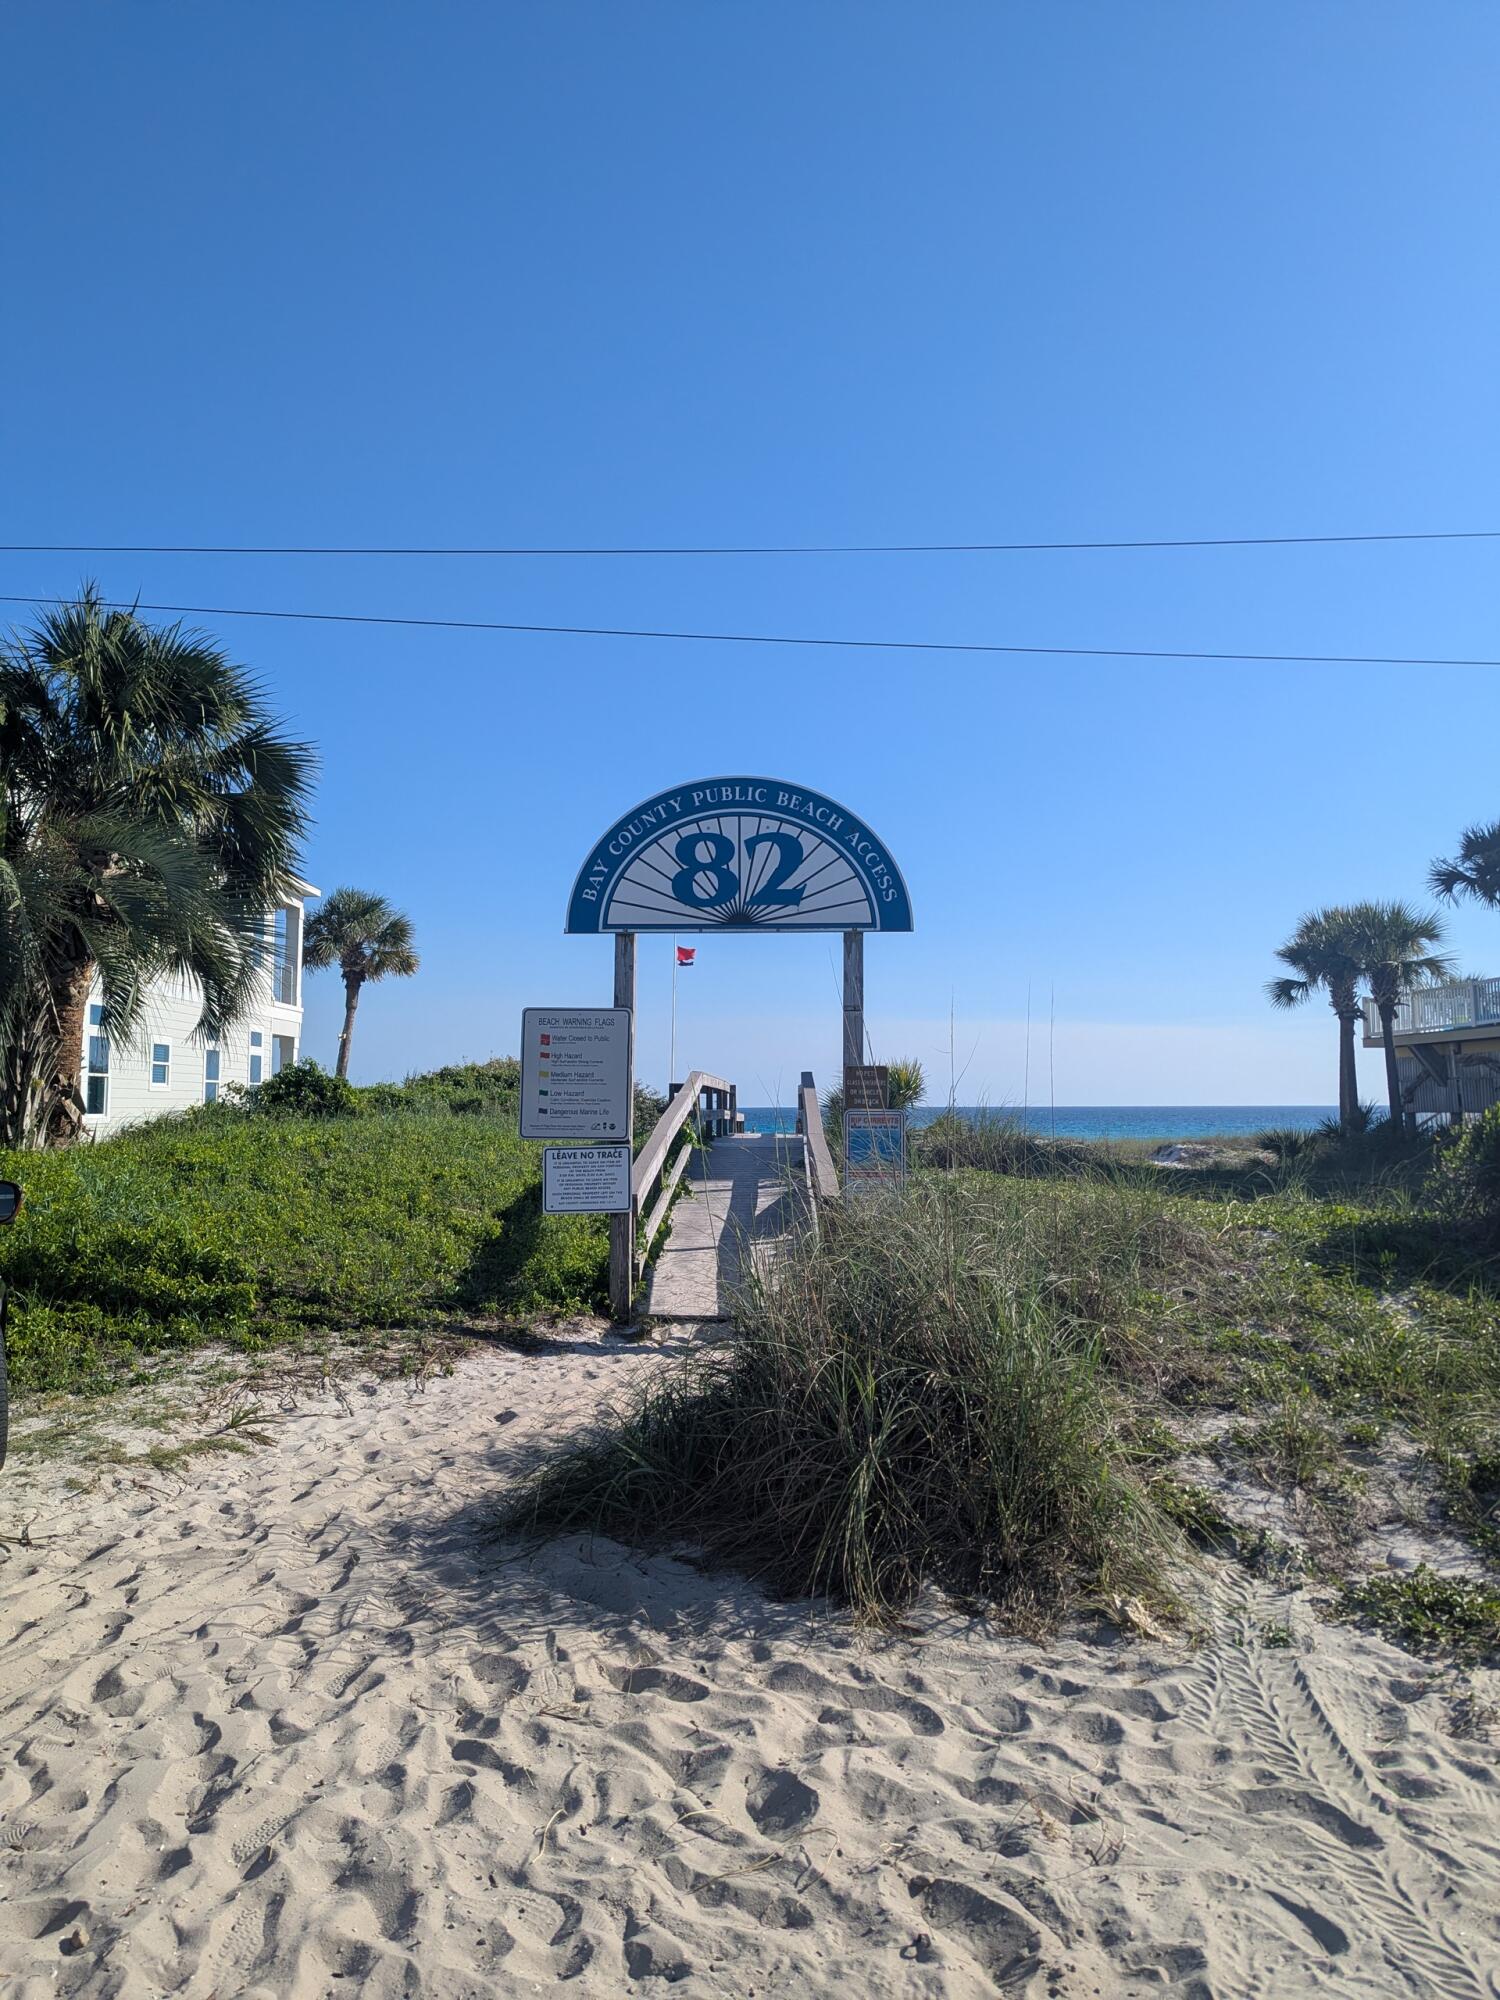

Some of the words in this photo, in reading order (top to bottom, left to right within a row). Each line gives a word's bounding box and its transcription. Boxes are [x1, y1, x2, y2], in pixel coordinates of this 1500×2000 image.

[582, 859, 610, 902] BAY
[608, 796, 684, 855] COUNTY
[691, 785, 768, 807] PUBLIC
[776, 791, 845, 832] BEACH
[847, 832, 898, 903] ACCESS
[671, 831, 808, 909] 82
[538, 1017, 560, 1026] BEACH
[562, 1017, 592, 1026] WARNING
[594, 1017, 615, 1026] FLAGS
[551, 1034, 567, 1042] Water
[568, 1034, 587, 1042] Closed
[551, 1052, 563, 1060] High
[549, 1108, 578, 1116] Dangerous
[579, 1108, 598, 1116] Marine
[552, 1152, 578, 1160] LEAVE
[580, 1151, 594, 1159] NO
[597, 1151, 623, 1159] TRACE
